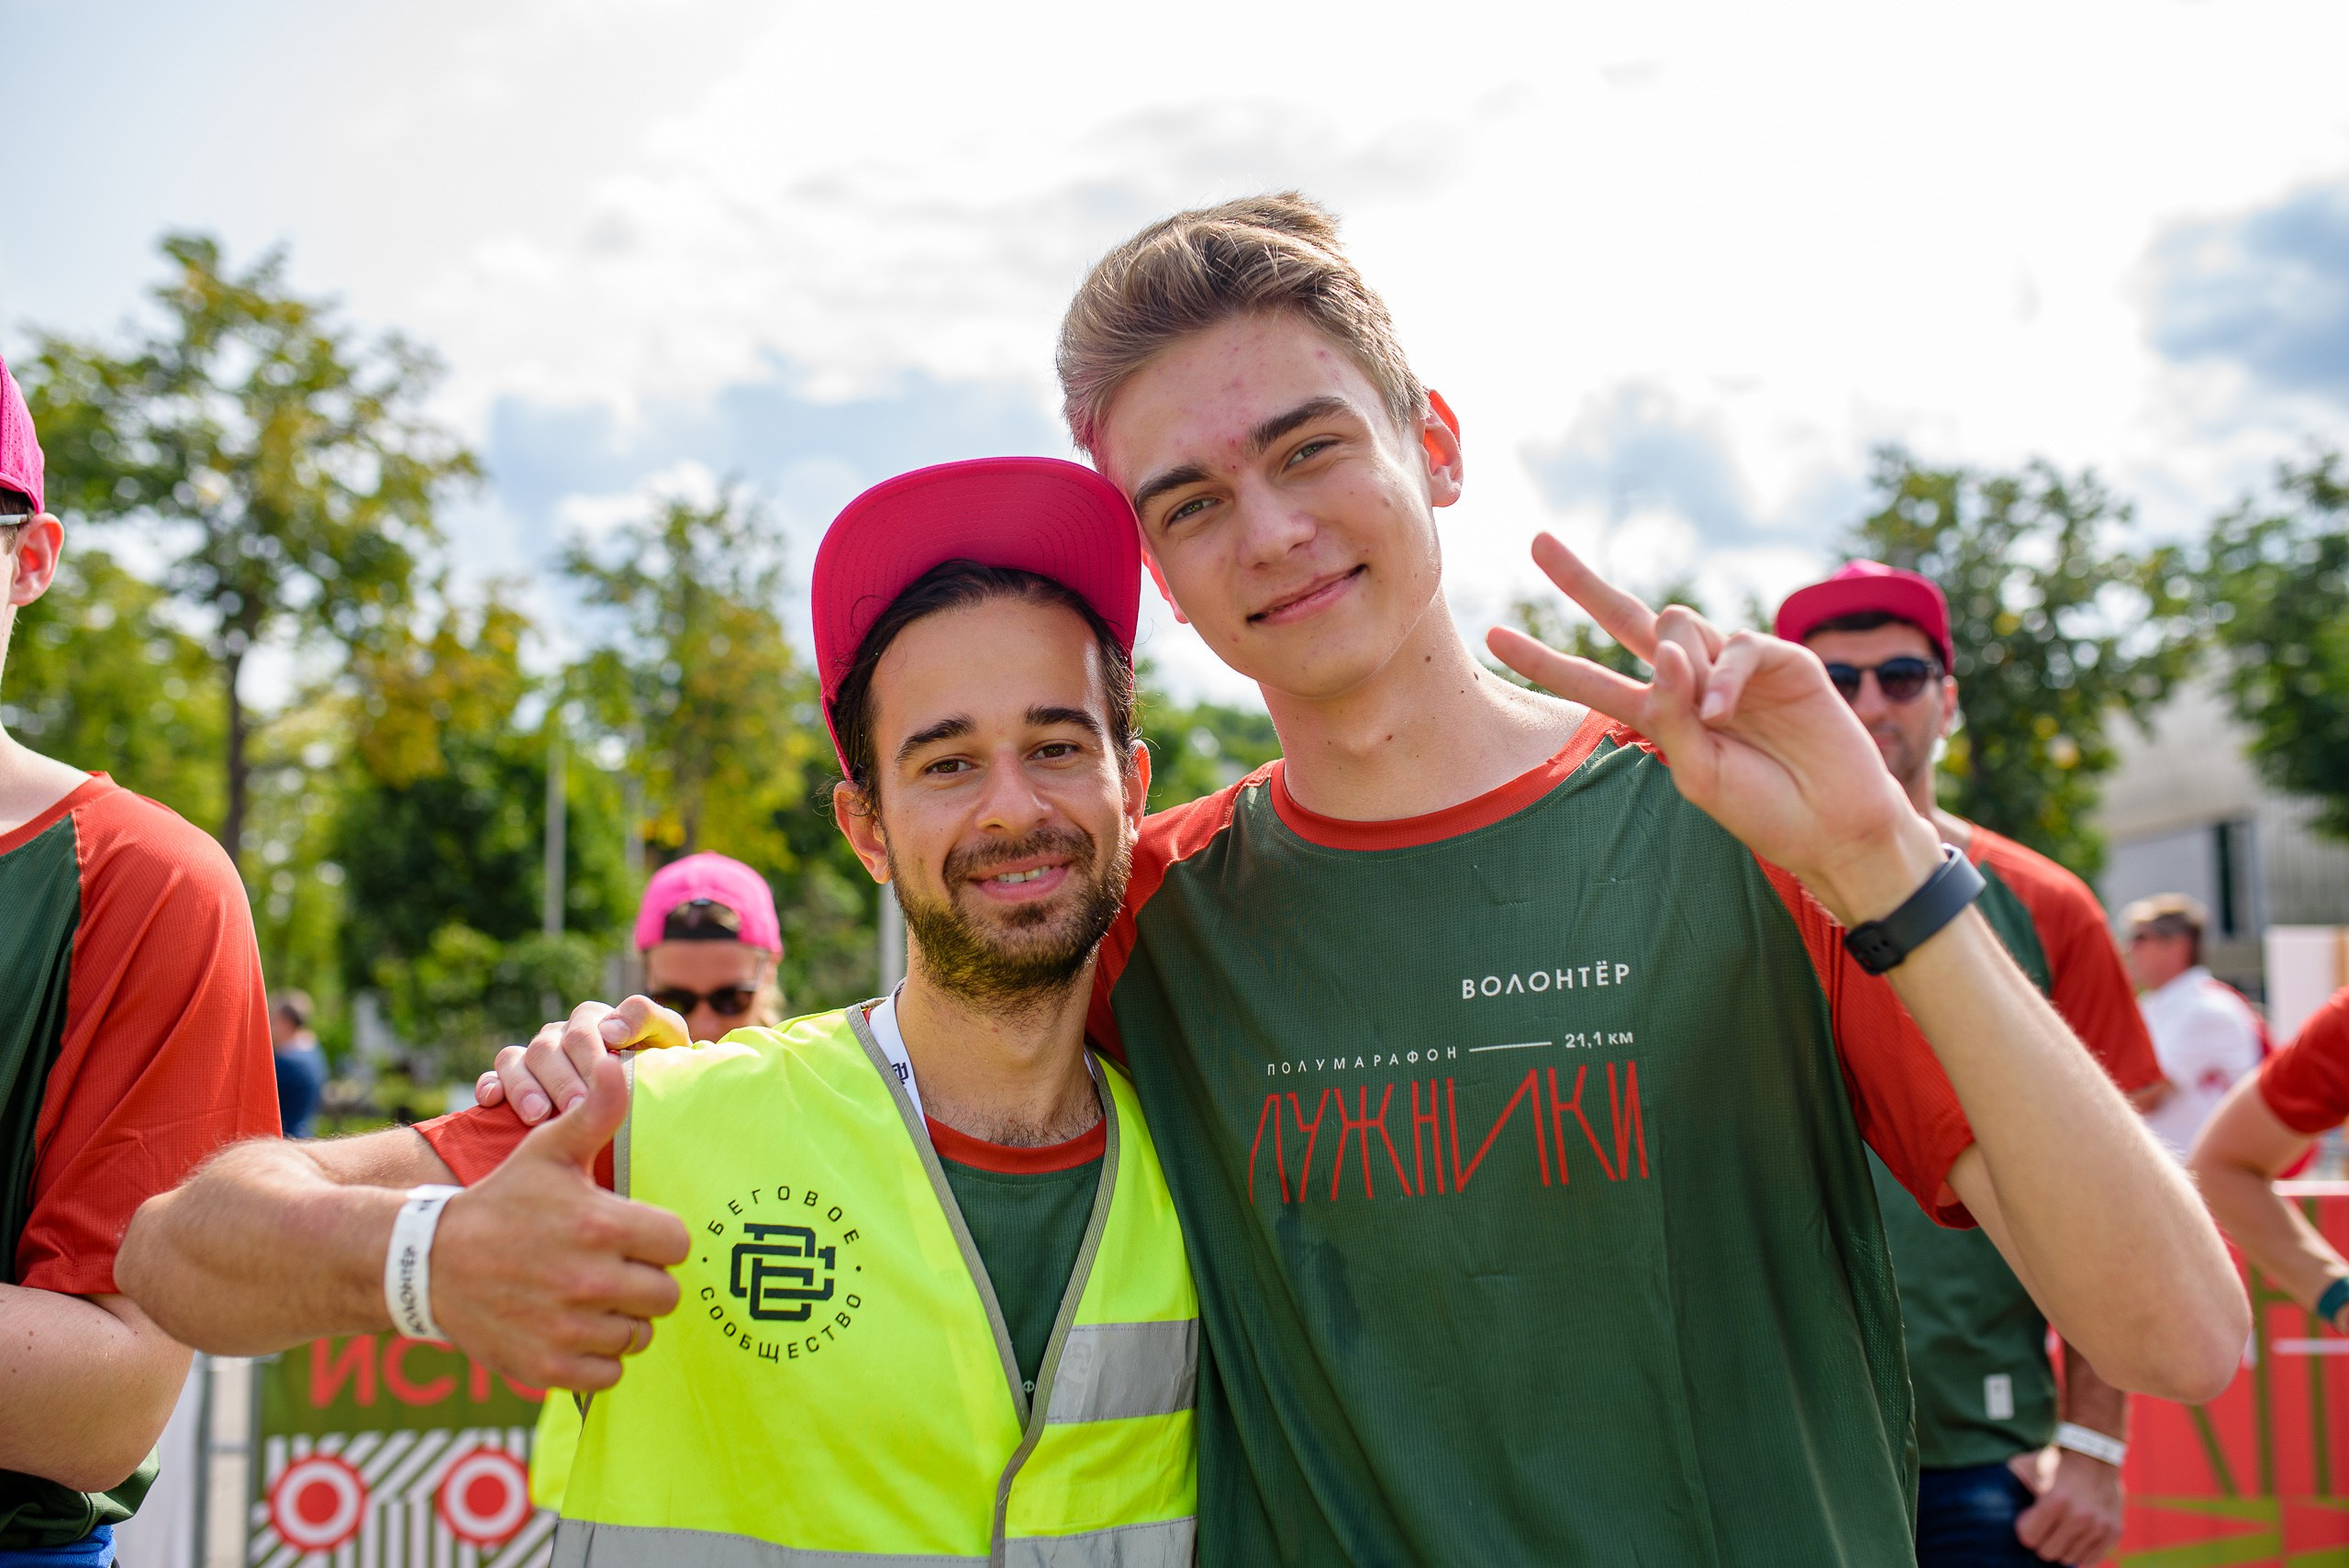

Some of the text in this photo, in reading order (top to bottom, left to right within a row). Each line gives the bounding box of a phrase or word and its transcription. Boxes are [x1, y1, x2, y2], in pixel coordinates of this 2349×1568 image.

[1462, 961, 1630, 999] ВОЛОНТЁР
[1267, 1046, 1457, 1075] ПОЛУМАРАФОН
[1564, 1031, 1602, 1049] 21,1
[1248, 1060, 1649, 1204] ЛУЖНИКИ
[707, 1185, 860, 1245] БЕГОВОЕ
[700, 1286, 862, 1363] СООБЩЕСТВО
